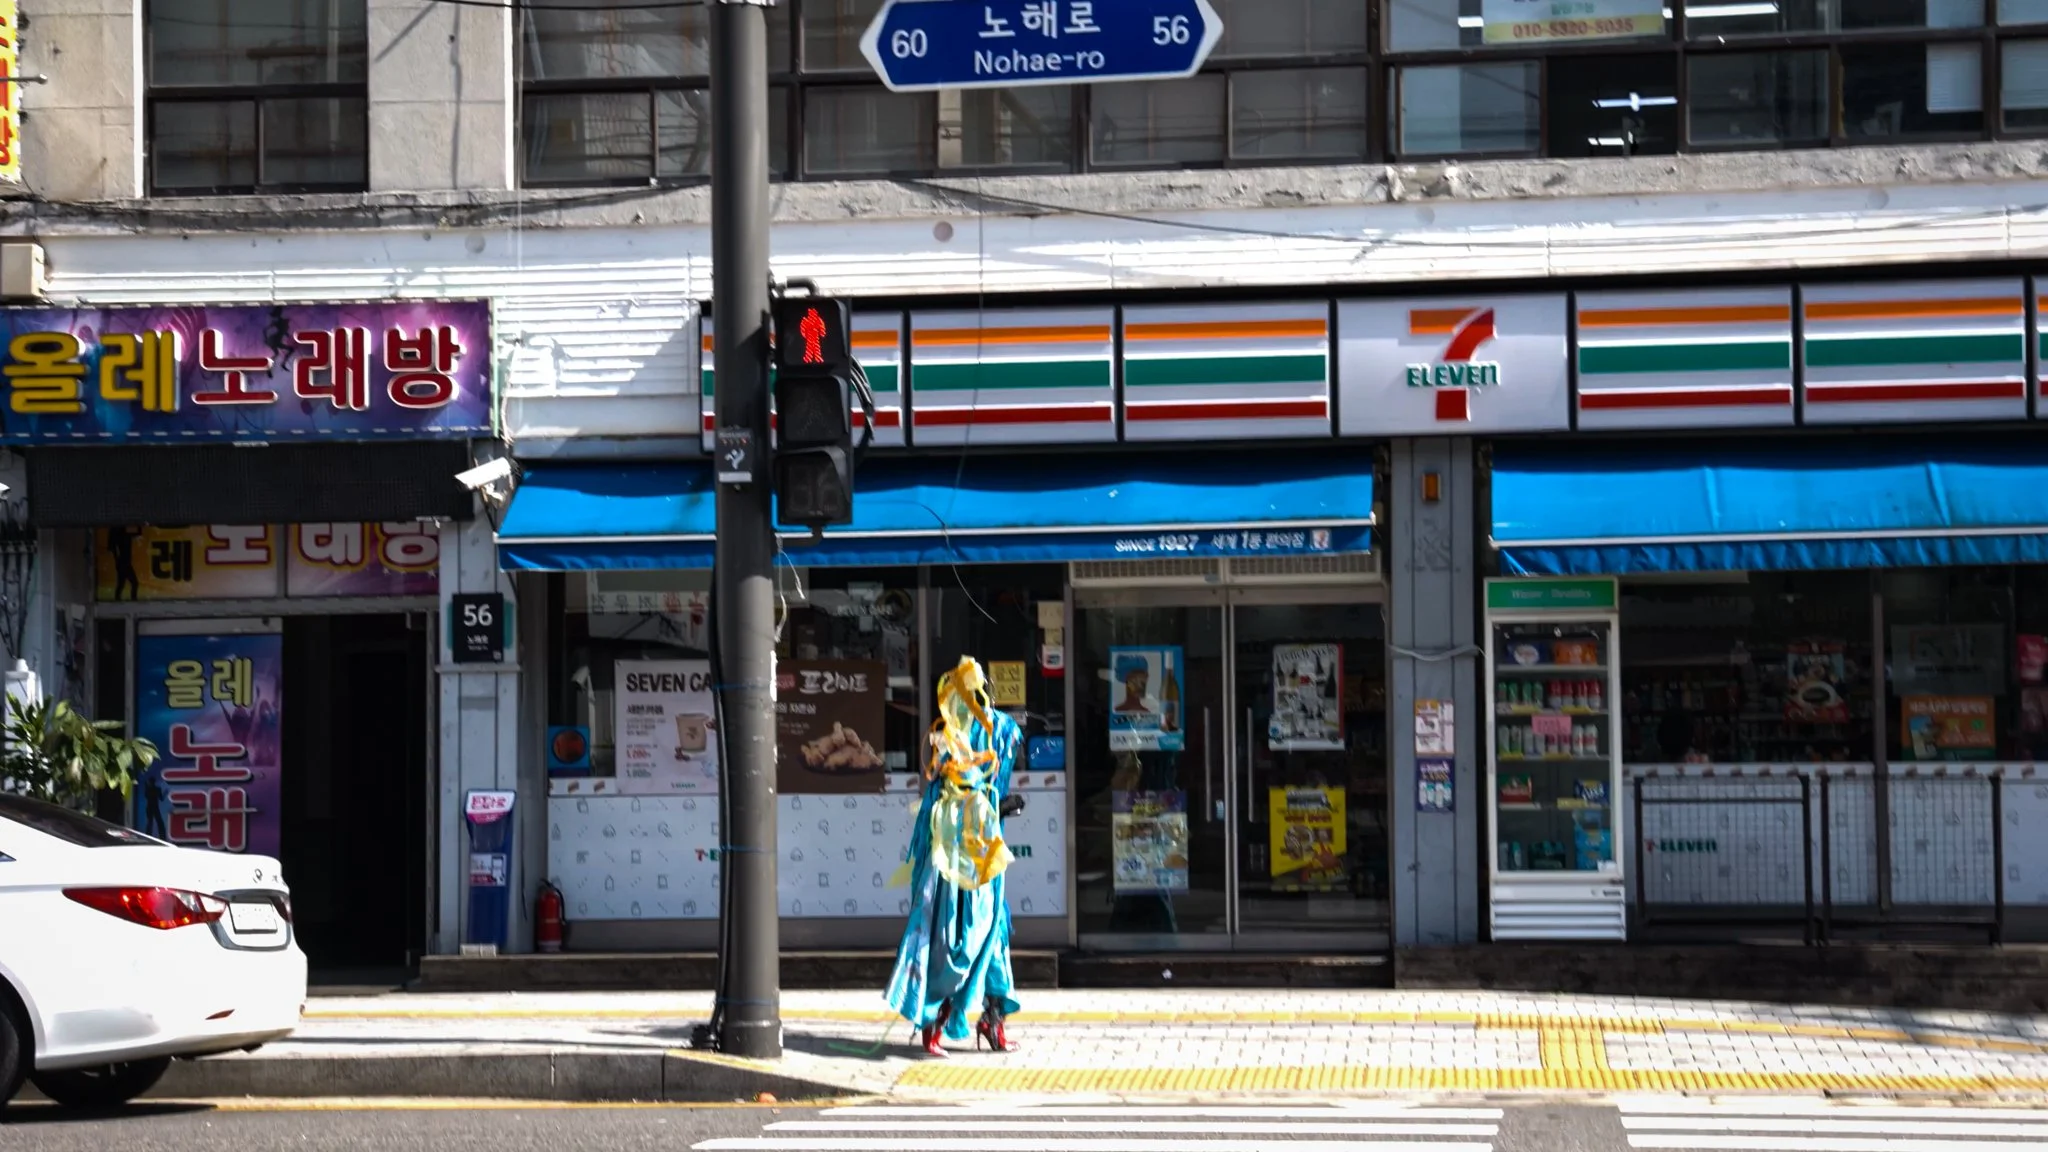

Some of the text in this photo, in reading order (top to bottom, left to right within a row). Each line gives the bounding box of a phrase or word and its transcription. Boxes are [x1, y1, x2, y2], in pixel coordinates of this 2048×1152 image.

[978, 1, 1100, 39] 노해로
[1153, 15, 1190, 46] 56
[891, 29, 928, 59] 60
[974, 50, 1105, 75] Nohae-ro
[3, 325, 465, 414] 올레 노래방
[1408, 307, 1498, 422] 7
[151, 525, 192, 582] 레
[1115, 534, 1199, 552] SINCE 1927
[463, 603, 493, 628] 56
[164, 657, 253, 708] 올레
[626, 672, 714, 693] SEVEN CA
